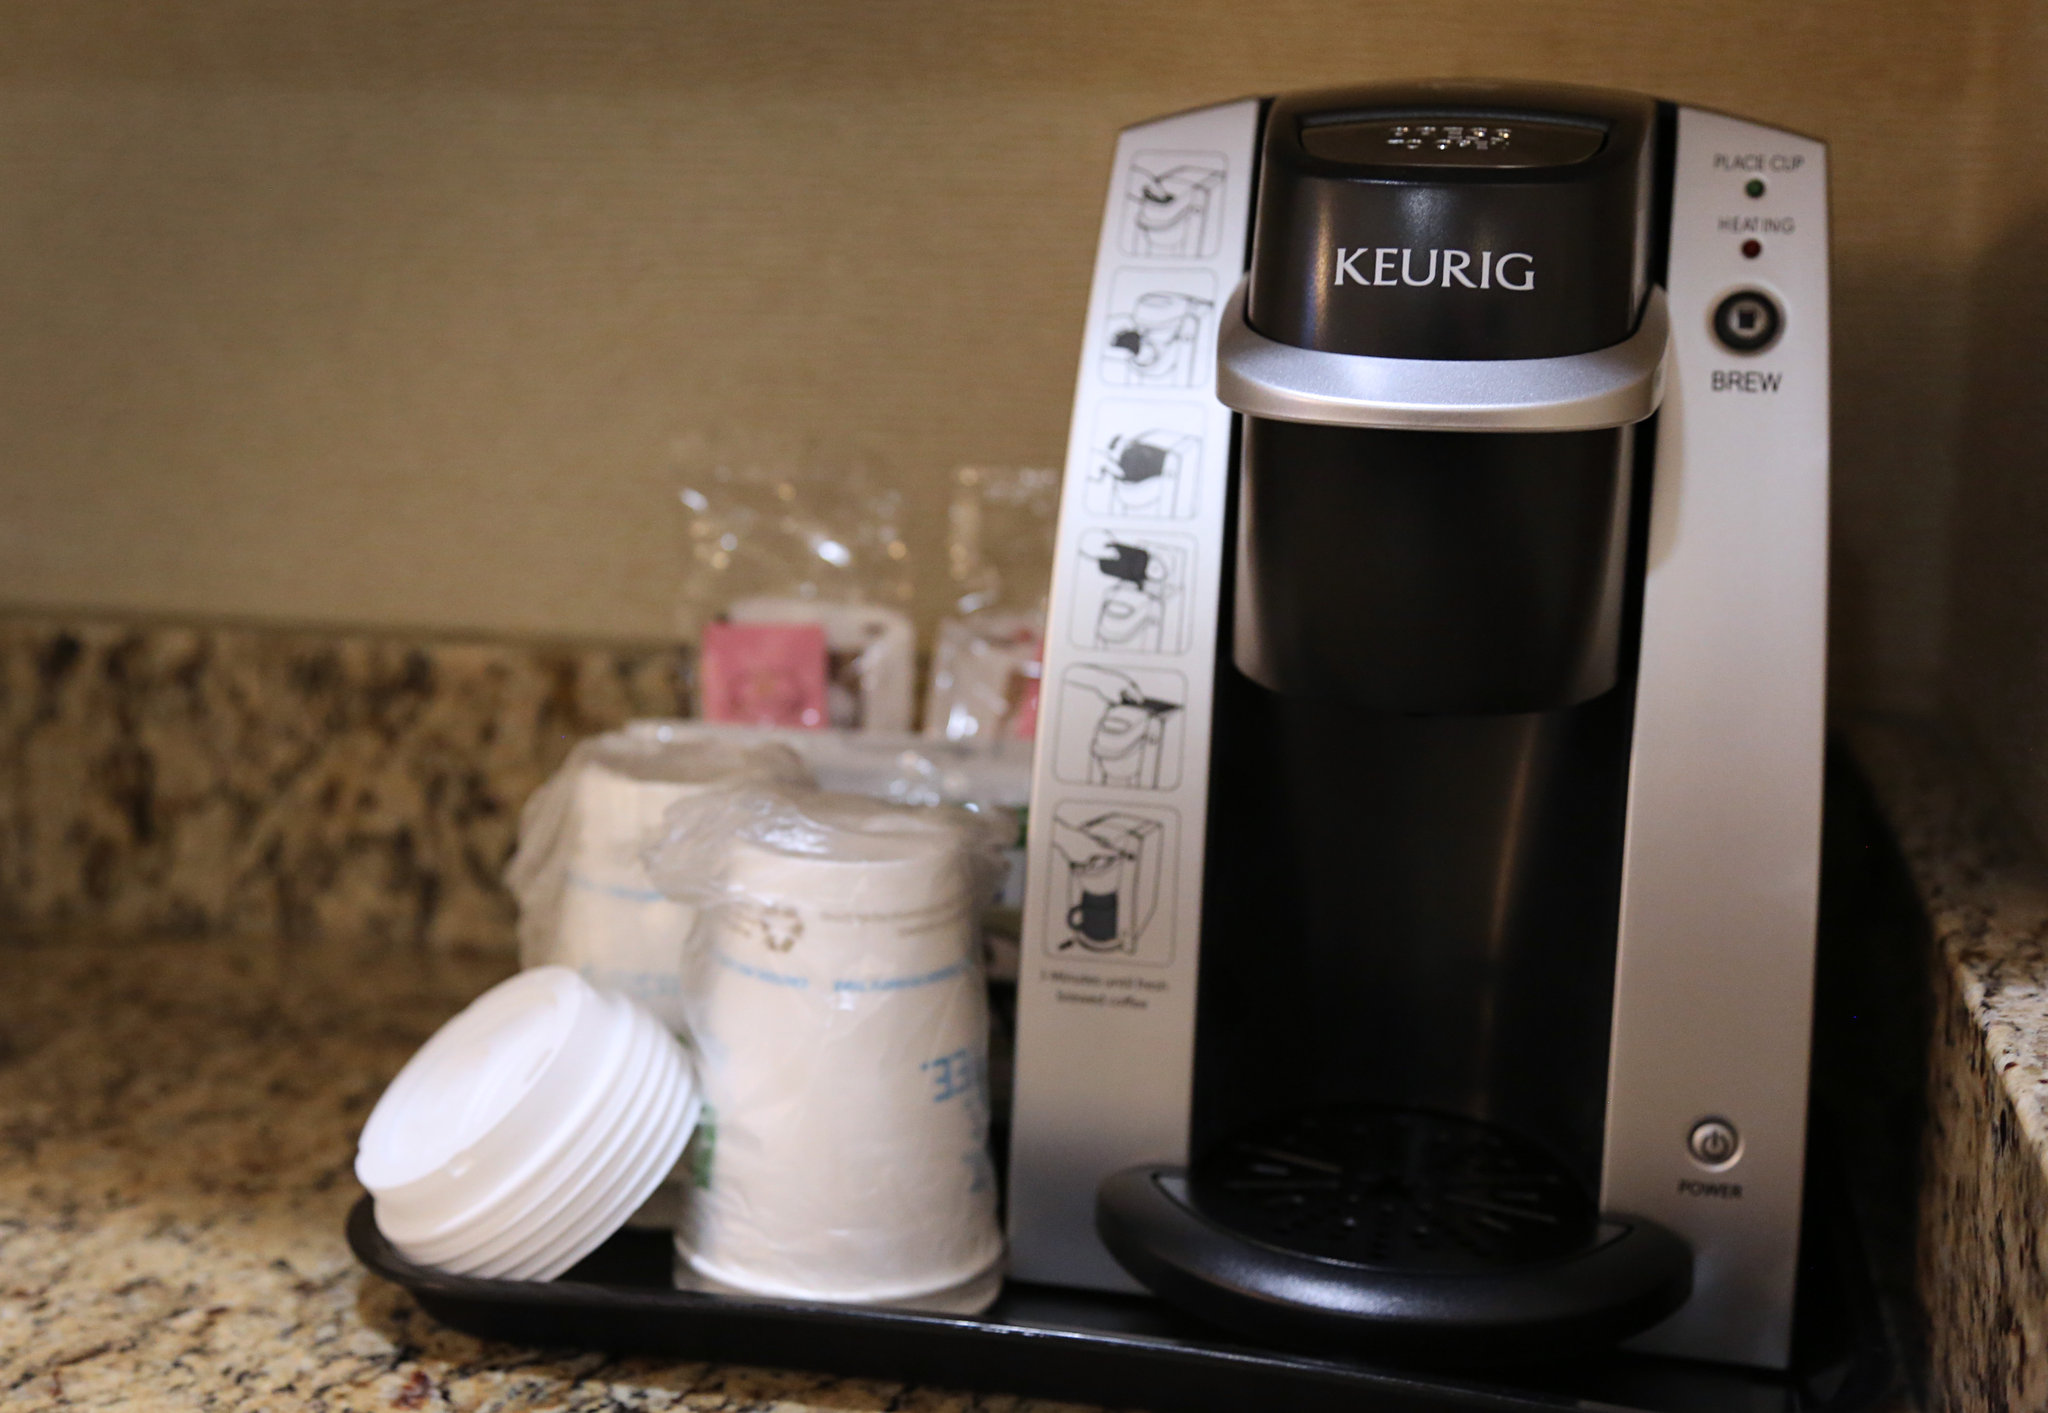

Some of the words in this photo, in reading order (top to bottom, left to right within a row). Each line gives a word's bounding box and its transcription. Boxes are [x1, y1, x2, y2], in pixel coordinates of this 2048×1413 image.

[1712, 153, 1763, 171] PLACE
[1768, 154, 1805, 172] CUP
[1717, 215, 1796, 235] HEATING
[1334, 248, 1536, 291] KEURIG
[1711, 370, 1782, 393] BREW
[1678, 1179, 1744, 1199] POWER
